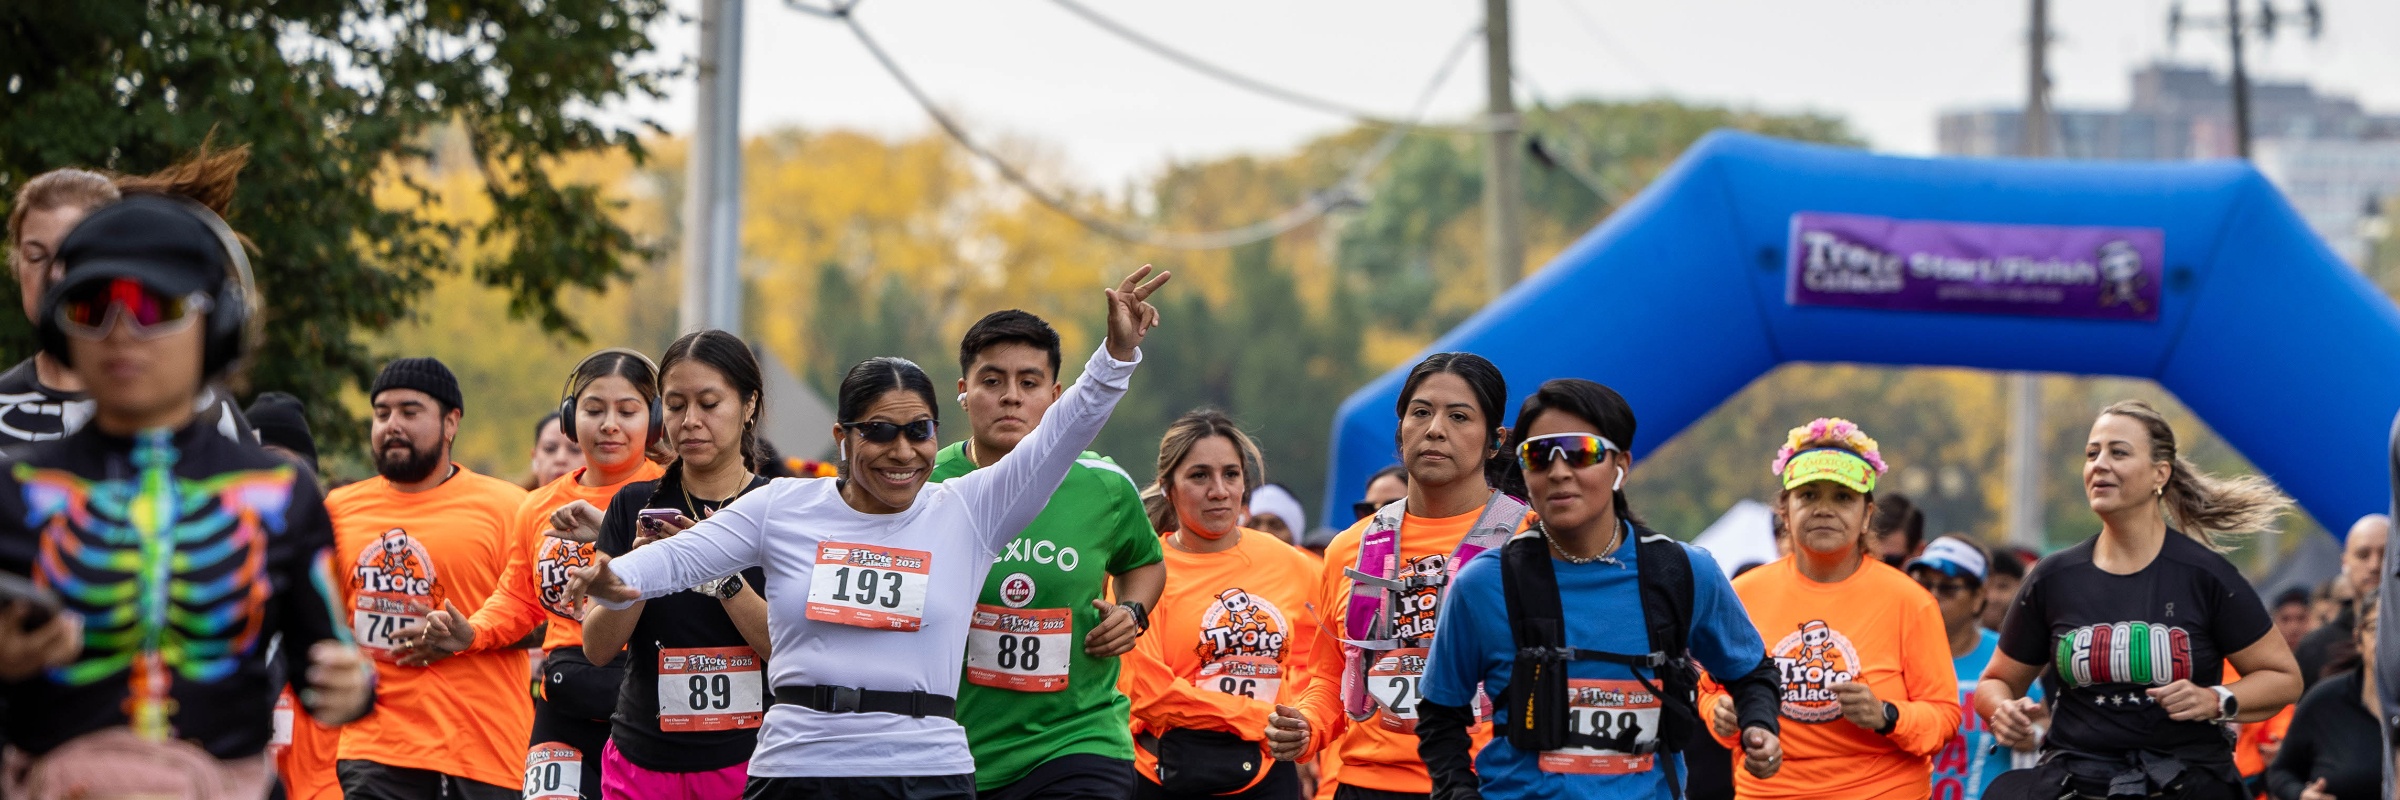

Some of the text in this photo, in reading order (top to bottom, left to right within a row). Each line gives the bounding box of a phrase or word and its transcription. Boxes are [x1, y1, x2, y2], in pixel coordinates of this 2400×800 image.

[896, 558, 921, 569] 2025
[993, 537, 1079, 572] XICO
[360, 566, 430, 596] Trote
[832, 567, 903, 608] 193
[1042, 621, 1064, 630] 2025
[1400, 610, 1435, 625] de las
[997, 634, 1041, 671] 88
[1207, 627, 1283, 655] Trote
[697, 654, 727, 666] Trote
[730, 658, 752, 667] 2025
[1774, 657, 1852, 689] Trote
[688, 674, 731, 711] 89
[1589, 687, 1654, 704] Trote 2025
[1787, 682, 1820, 690] de las
